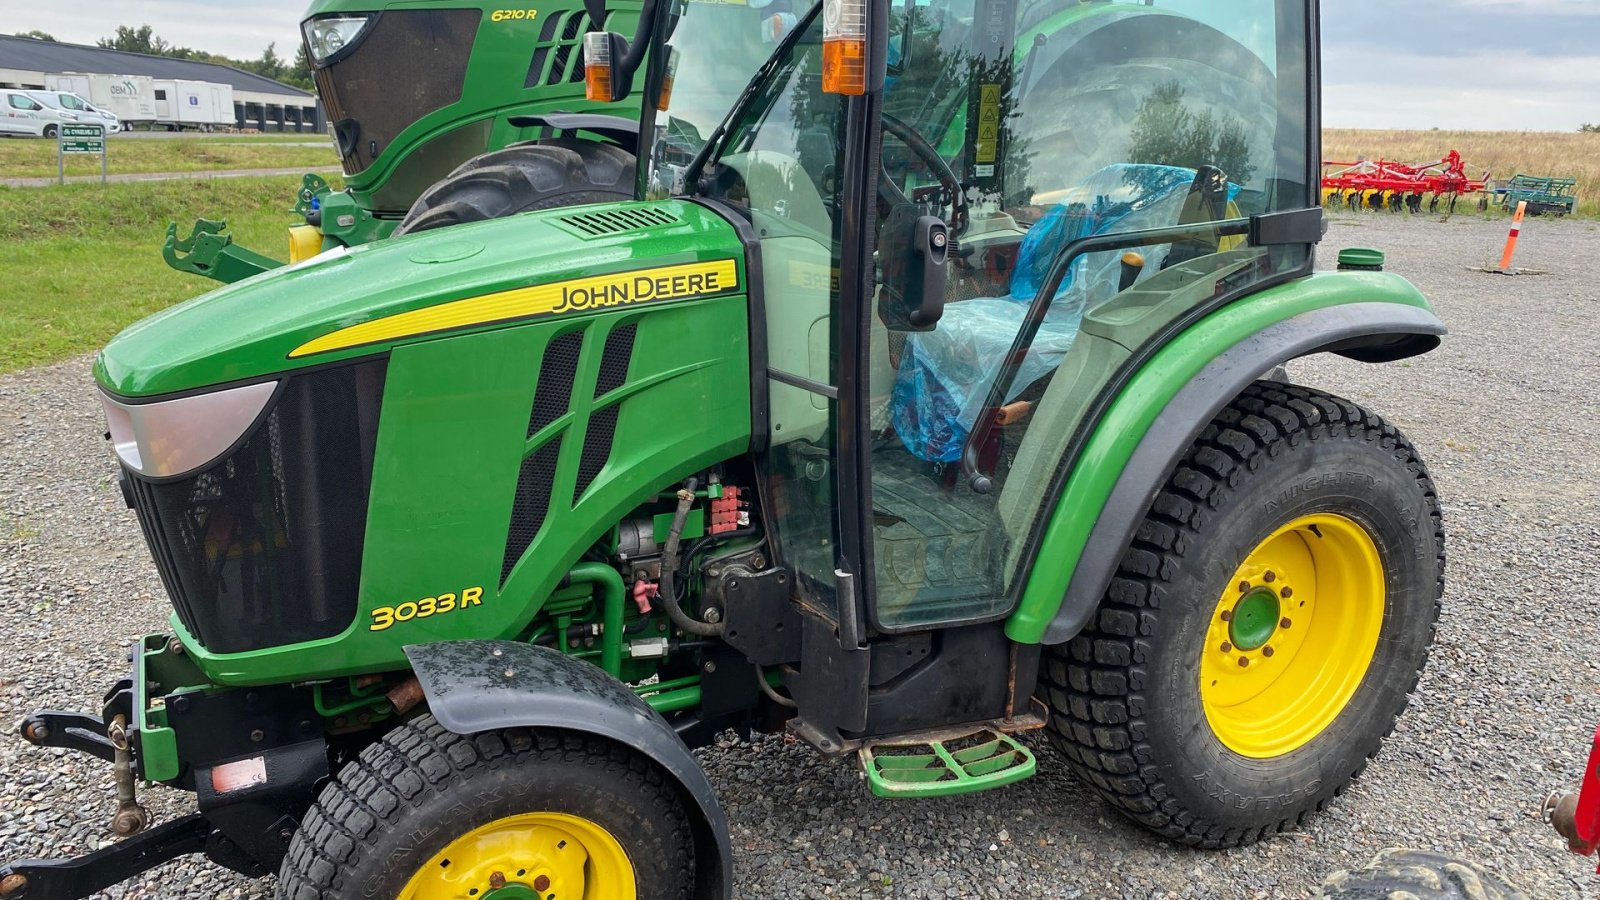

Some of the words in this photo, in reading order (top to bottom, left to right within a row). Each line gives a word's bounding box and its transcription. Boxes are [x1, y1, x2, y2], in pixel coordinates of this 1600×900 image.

[491, 10, 524, 22] 6210
[525, 9, 538, 20] R
[552, 282, 630, 312] JOHN
[633, 271, 721, 301] DEERE
[1264, 470, 1383, 516] MIGHTY
[369, 592, 458, 632] 3033
[460, 586, 484, 609] R
[1191, 769, 1324, 811] GALAXY
[361, 781, 535, 899] GALAXY
